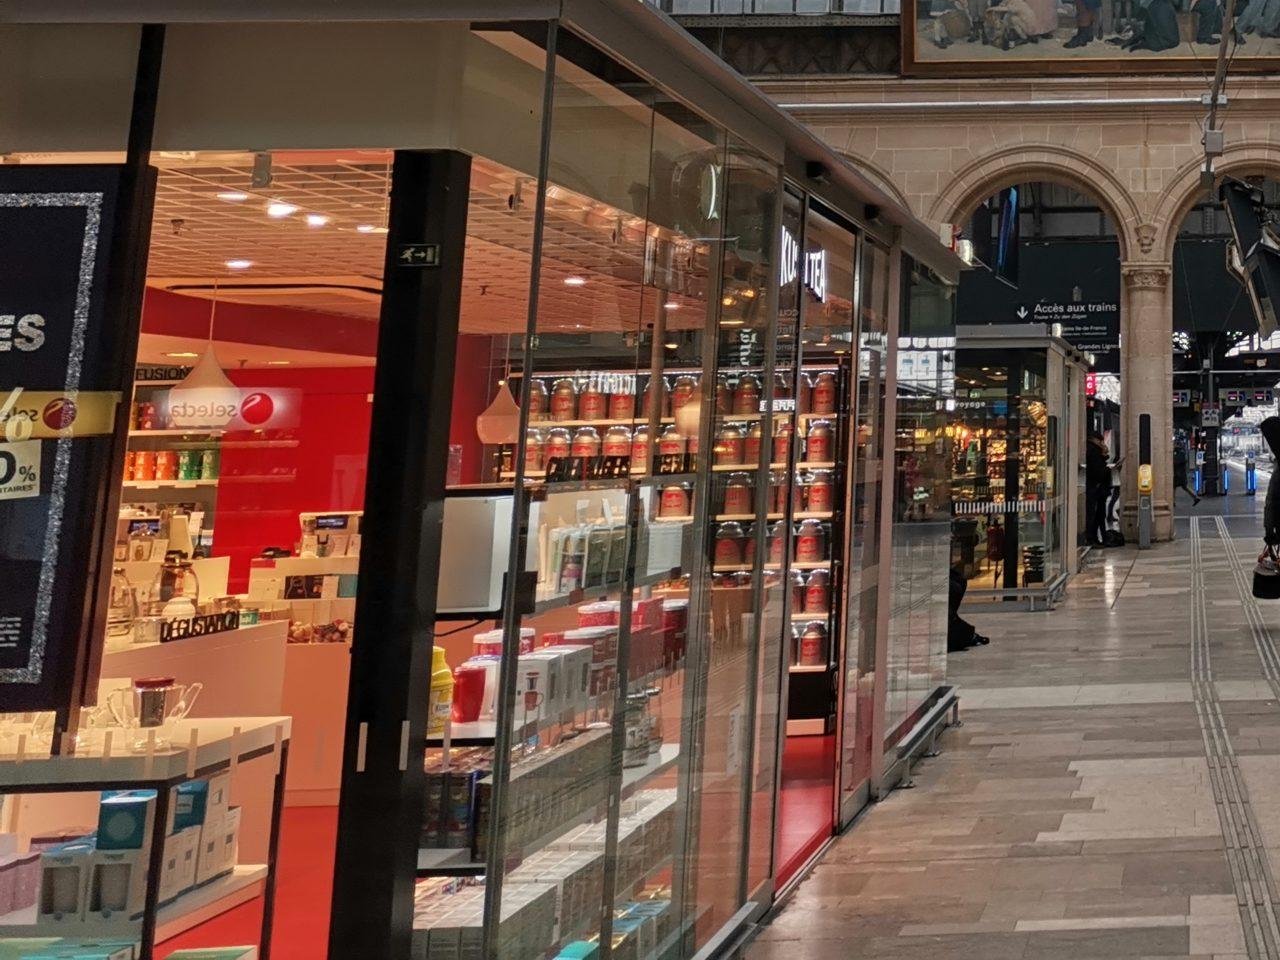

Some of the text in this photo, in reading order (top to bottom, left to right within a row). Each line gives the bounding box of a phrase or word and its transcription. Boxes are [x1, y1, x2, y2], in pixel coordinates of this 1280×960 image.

[1034, 302, 1117, 313] Accès aux trains
